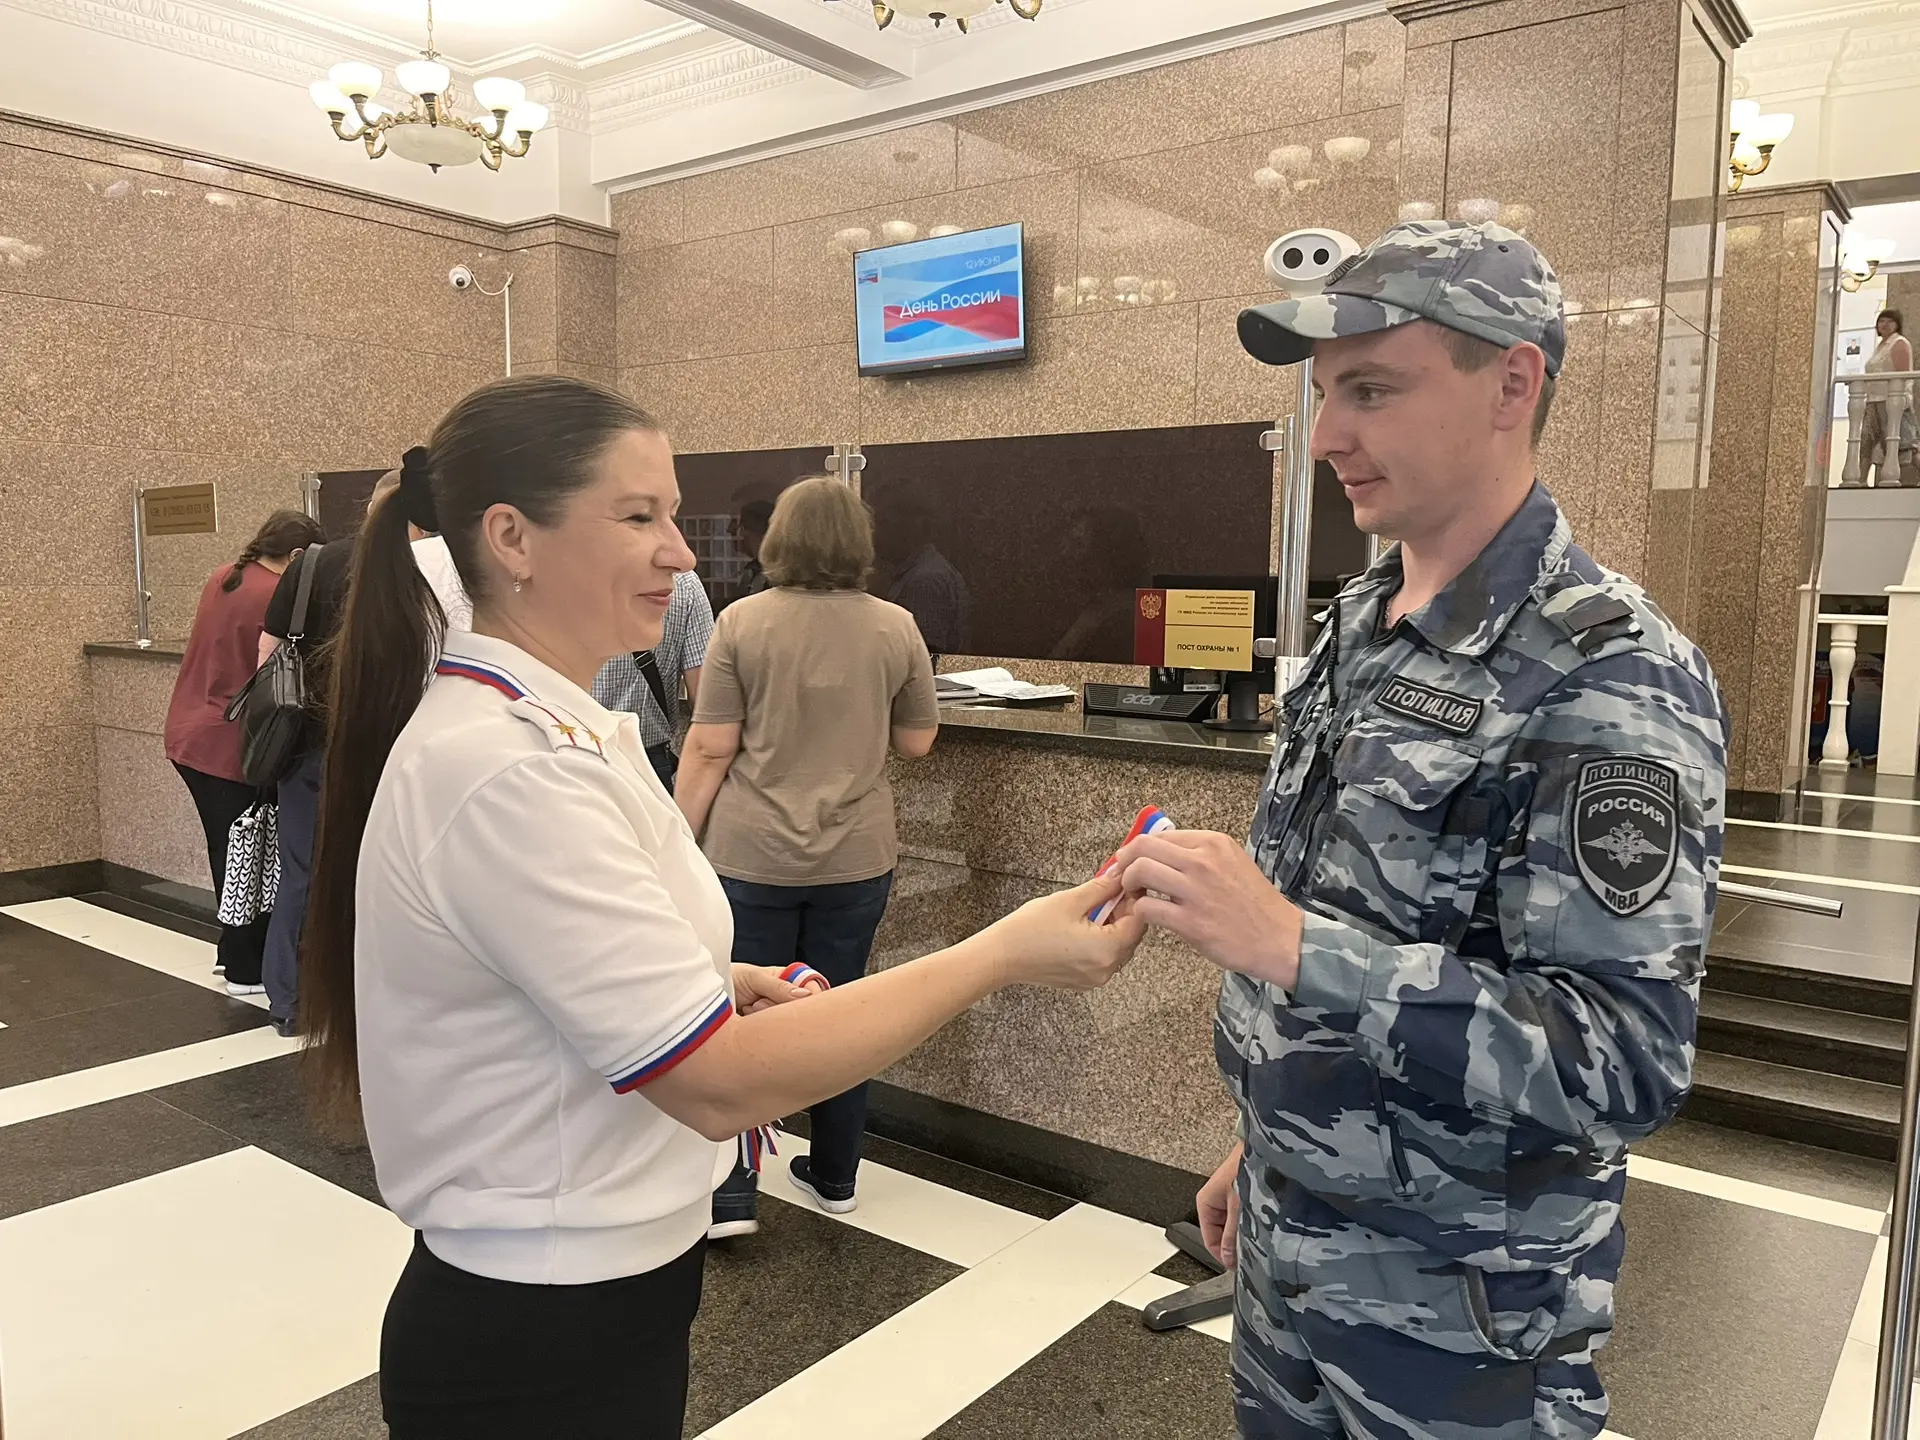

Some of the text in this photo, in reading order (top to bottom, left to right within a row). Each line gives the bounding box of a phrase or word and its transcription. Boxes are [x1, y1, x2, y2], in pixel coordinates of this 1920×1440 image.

[900, 289, 1001, 318] День России
[1122, 693, 1161, 705] acer
[1386, 685, 1475, 724] ПОЛИЦИЯ
[1588, 765, 1669, 791] ПОЛИЦИЯ
[1587, 797, 1666, 828] РОССИЯ
[1605, 886, 1640, 910] МВД
